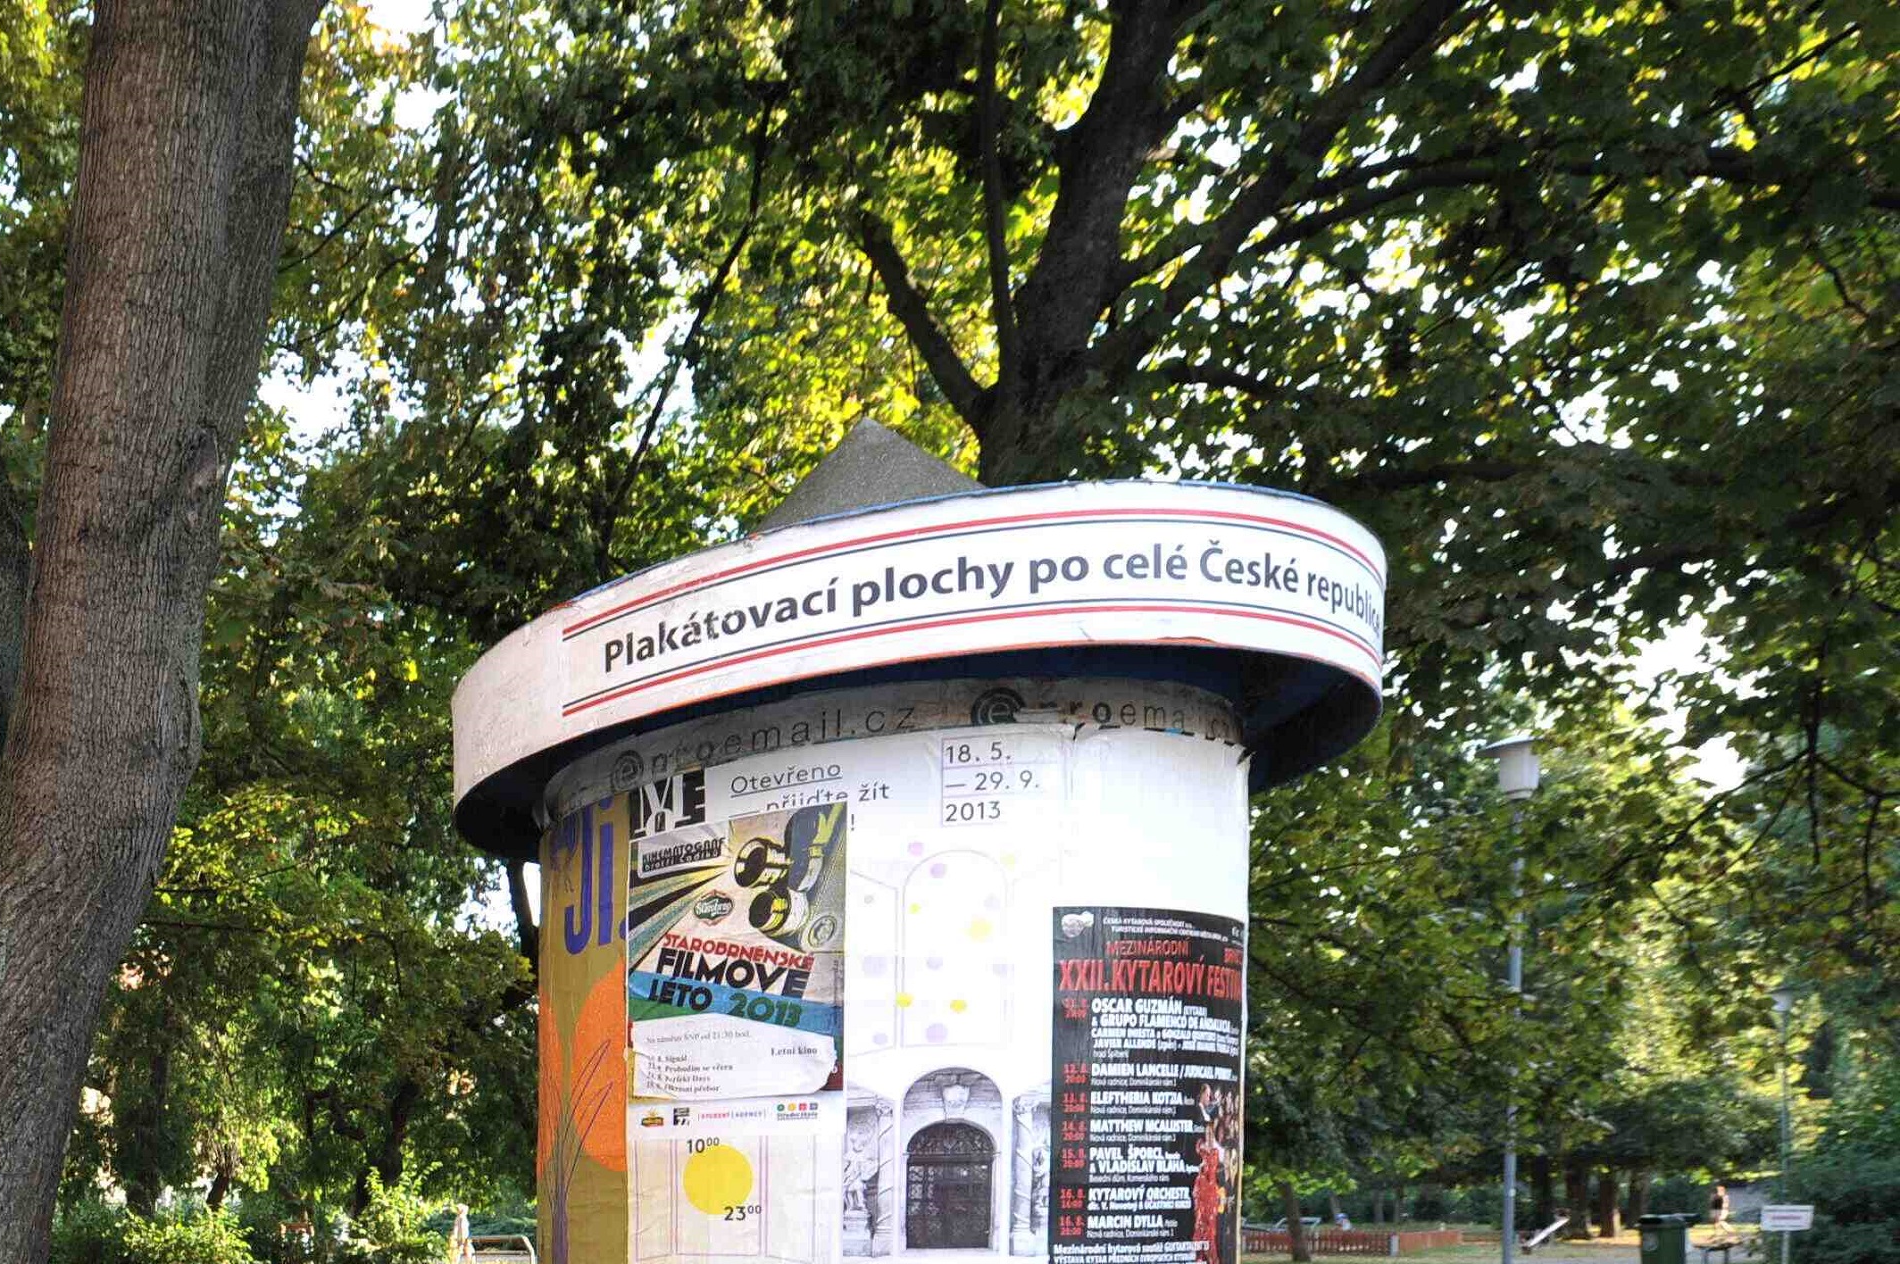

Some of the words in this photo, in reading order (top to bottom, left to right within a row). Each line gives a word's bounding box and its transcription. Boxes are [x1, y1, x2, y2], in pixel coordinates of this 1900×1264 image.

[604, 577, 838, 672] Plakátovací
[852, 556, 1014, 617] plochy
[1029, 555, 1090, 594] po
[1103, 543, 1188, 580] celé
[1199, 539, 1299, 593] České
[945, 745, 981, 764] 18.
[990, 742, 1011, 761] 5.
[731, 764, 842, 793] Otevřeno
[975, 772, 1010, 791] 29.
[1020, 770, 1039, 789] 9.
[945, 801, 1001, 823] 2013
[1112, 954, 1205, 995] KYTAROVÝ
[728, 992, 802, 1027] 2013
[1092, 998, 1132, 1014] OSCAR
[1135, 996, 1182, 1014] GUZMÁN
[1100, 1014, 1137, 1028] GRUPO
[798, 1047, 818, 1055] kino
[1090, 1119, 1144, 1132] MATTHEW
[1099, 1160, 1156, 1173] VLADISLAV
[1088, 1184, 1146, 1201] KYTAROVÝ
[1087, 1215, 1131, 1229] MARCIN
[1133, 1214, 1164, 1228] DYLLA
